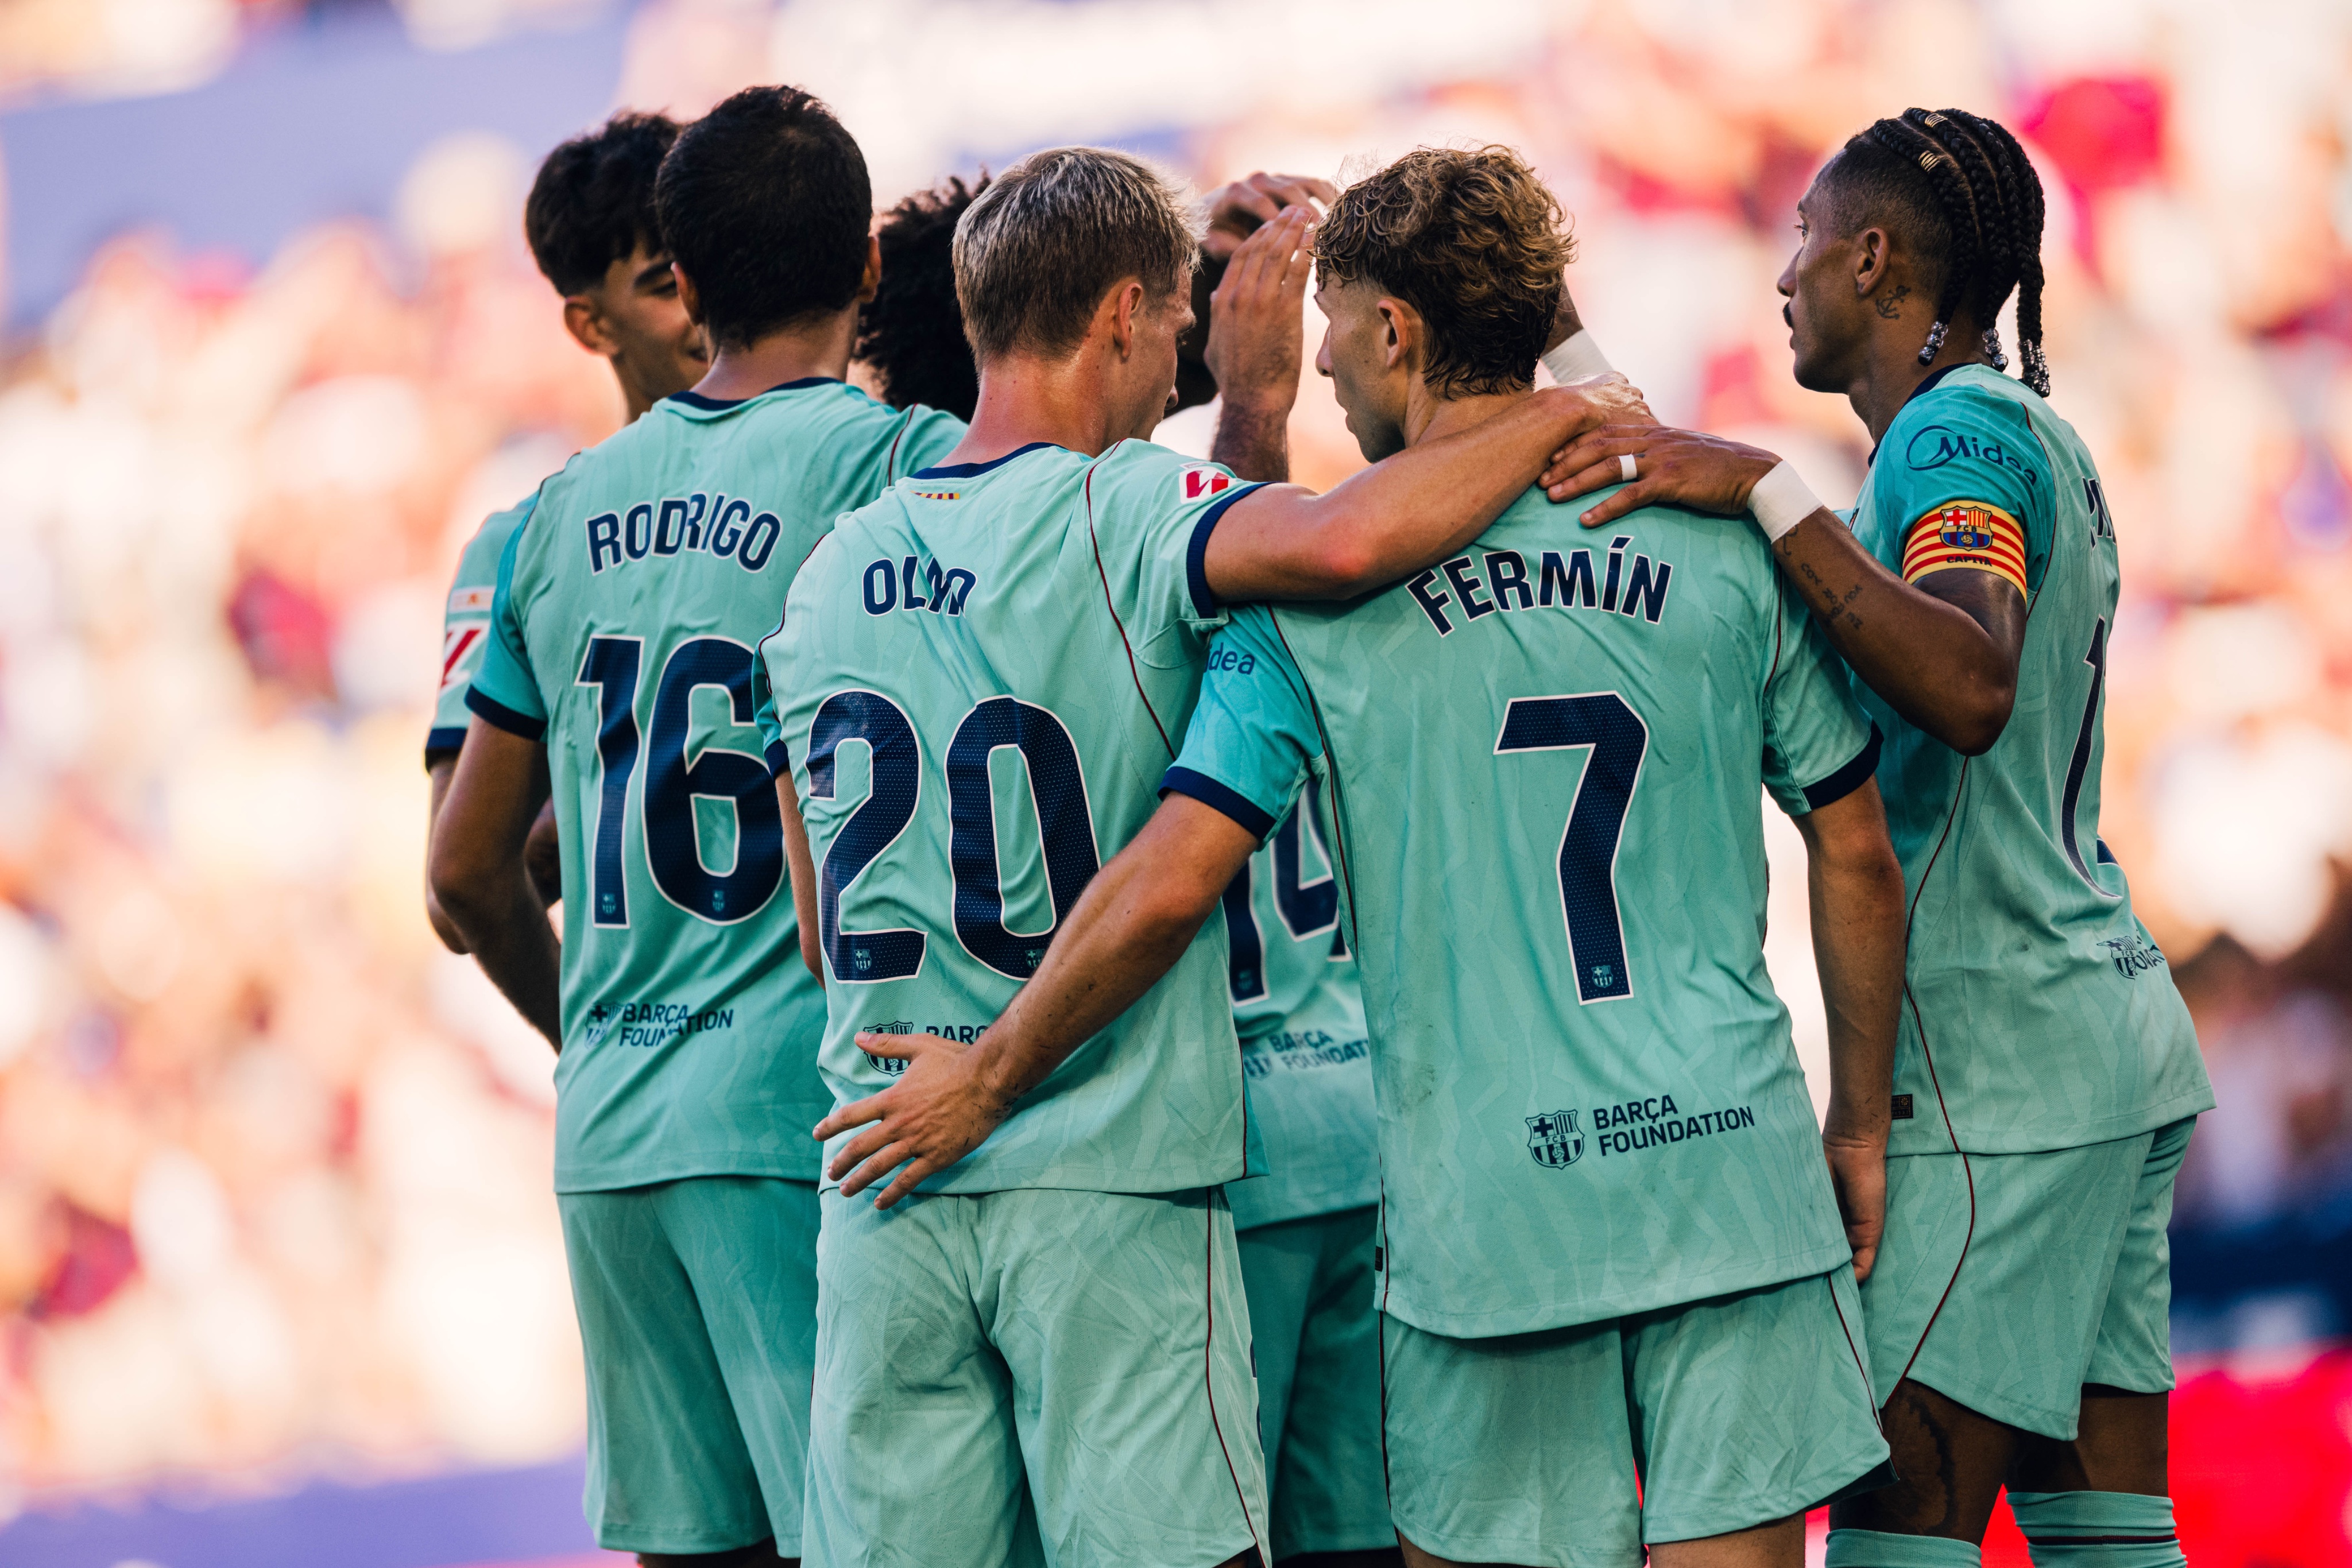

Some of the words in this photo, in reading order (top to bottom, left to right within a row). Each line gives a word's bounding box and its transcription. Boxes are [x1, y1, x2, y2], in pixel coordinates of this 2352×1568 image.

[585, 491, 782, 575] RODRIGO
[1406, 535, 1673, 637] FERMÍN
[574, 634, 787, 929] 16
[805, 688, 1101, 984] 20
[1494, 691, 1649, 1005] 7
[622, 1002, 688, 1027] BARÇA
[1282, 1039, 1369, 1070] FOUNDAT
[1545, 1135, 1566, 1144] FCB
[1593, 1094, 1678, 1130] BARÇA
[1598, 1106, 1755, 1156] FOUNDATION
